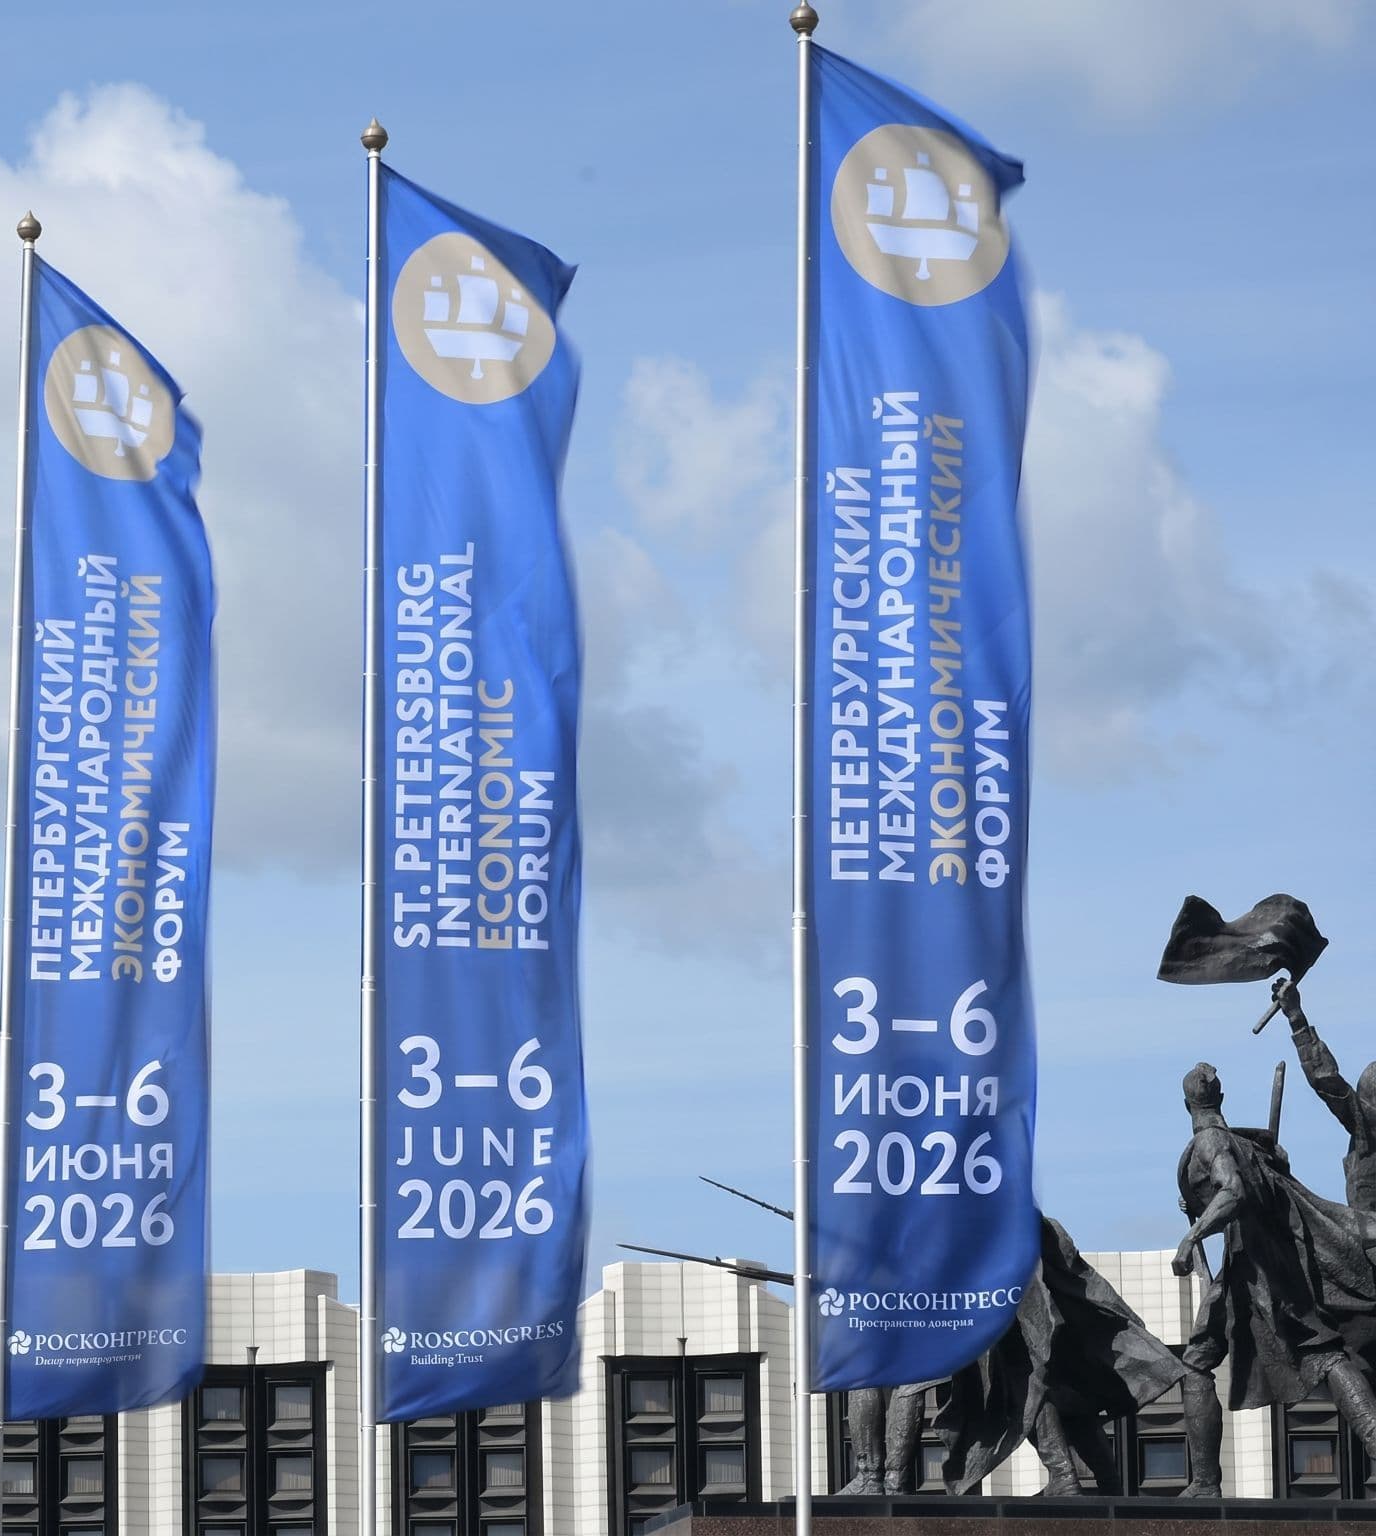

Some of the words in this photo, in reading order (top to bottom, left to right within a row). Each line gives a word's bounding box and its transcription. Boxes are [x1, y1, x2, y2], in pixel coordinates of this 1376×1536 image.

[826, 466, 871, 881] ПЕТЕРБУРГСКИЙ
[873, 391, 921, 883] МЕЖДУНАРОДНЫЙ
[923, 412, 967, 887] ЭКОНОМИЧЕСКИЙ
[69, 554, 118, 980] МЕЖДУНАРОДНЫЙ
[395, 563, 435, 871] PETERSBURG
[436, 542, 475, 948] INTERNATIONAL
[30, 618, 76, 980] ПЕТЕРБУРГСКИЙ
[111, 575, 162, 983] ЭКОНОМИЧЕСКИЙ
[477, 678, 514, 950] ECONOMIC
[974, 699, 1010, 888] ФОРУМ
[152, 821, 190, 983] ФОРУМ
[394, 885, 431, 949] ST.
[518, 770, 555, 950] FORUM
[396, 1126, 554, 1166] JUNE
[834, 1073, 999, 1117] ИЮНЯ
[25, 1143, 173, 1182] ИЮНЯ
[397, 1175, 554, 1239] 2026
[832, 1129, 1003, 1196] 2026
[24, 1192, 174, 1250] 2026
[35, 1328, 187, 1351] РОСКОНГРЕСС
[410, 1320, 564, 1348] ROSCONGRESS
[848, 1286, 1021, 1311] РОСКОНГРЕСС
[848, 1316, 926, 1331] Пространство
[927, 1316, 974, 1330] доверия
[411, 1353, 454, 1367] Building
[455, 1353, 483, 1364] Trust
